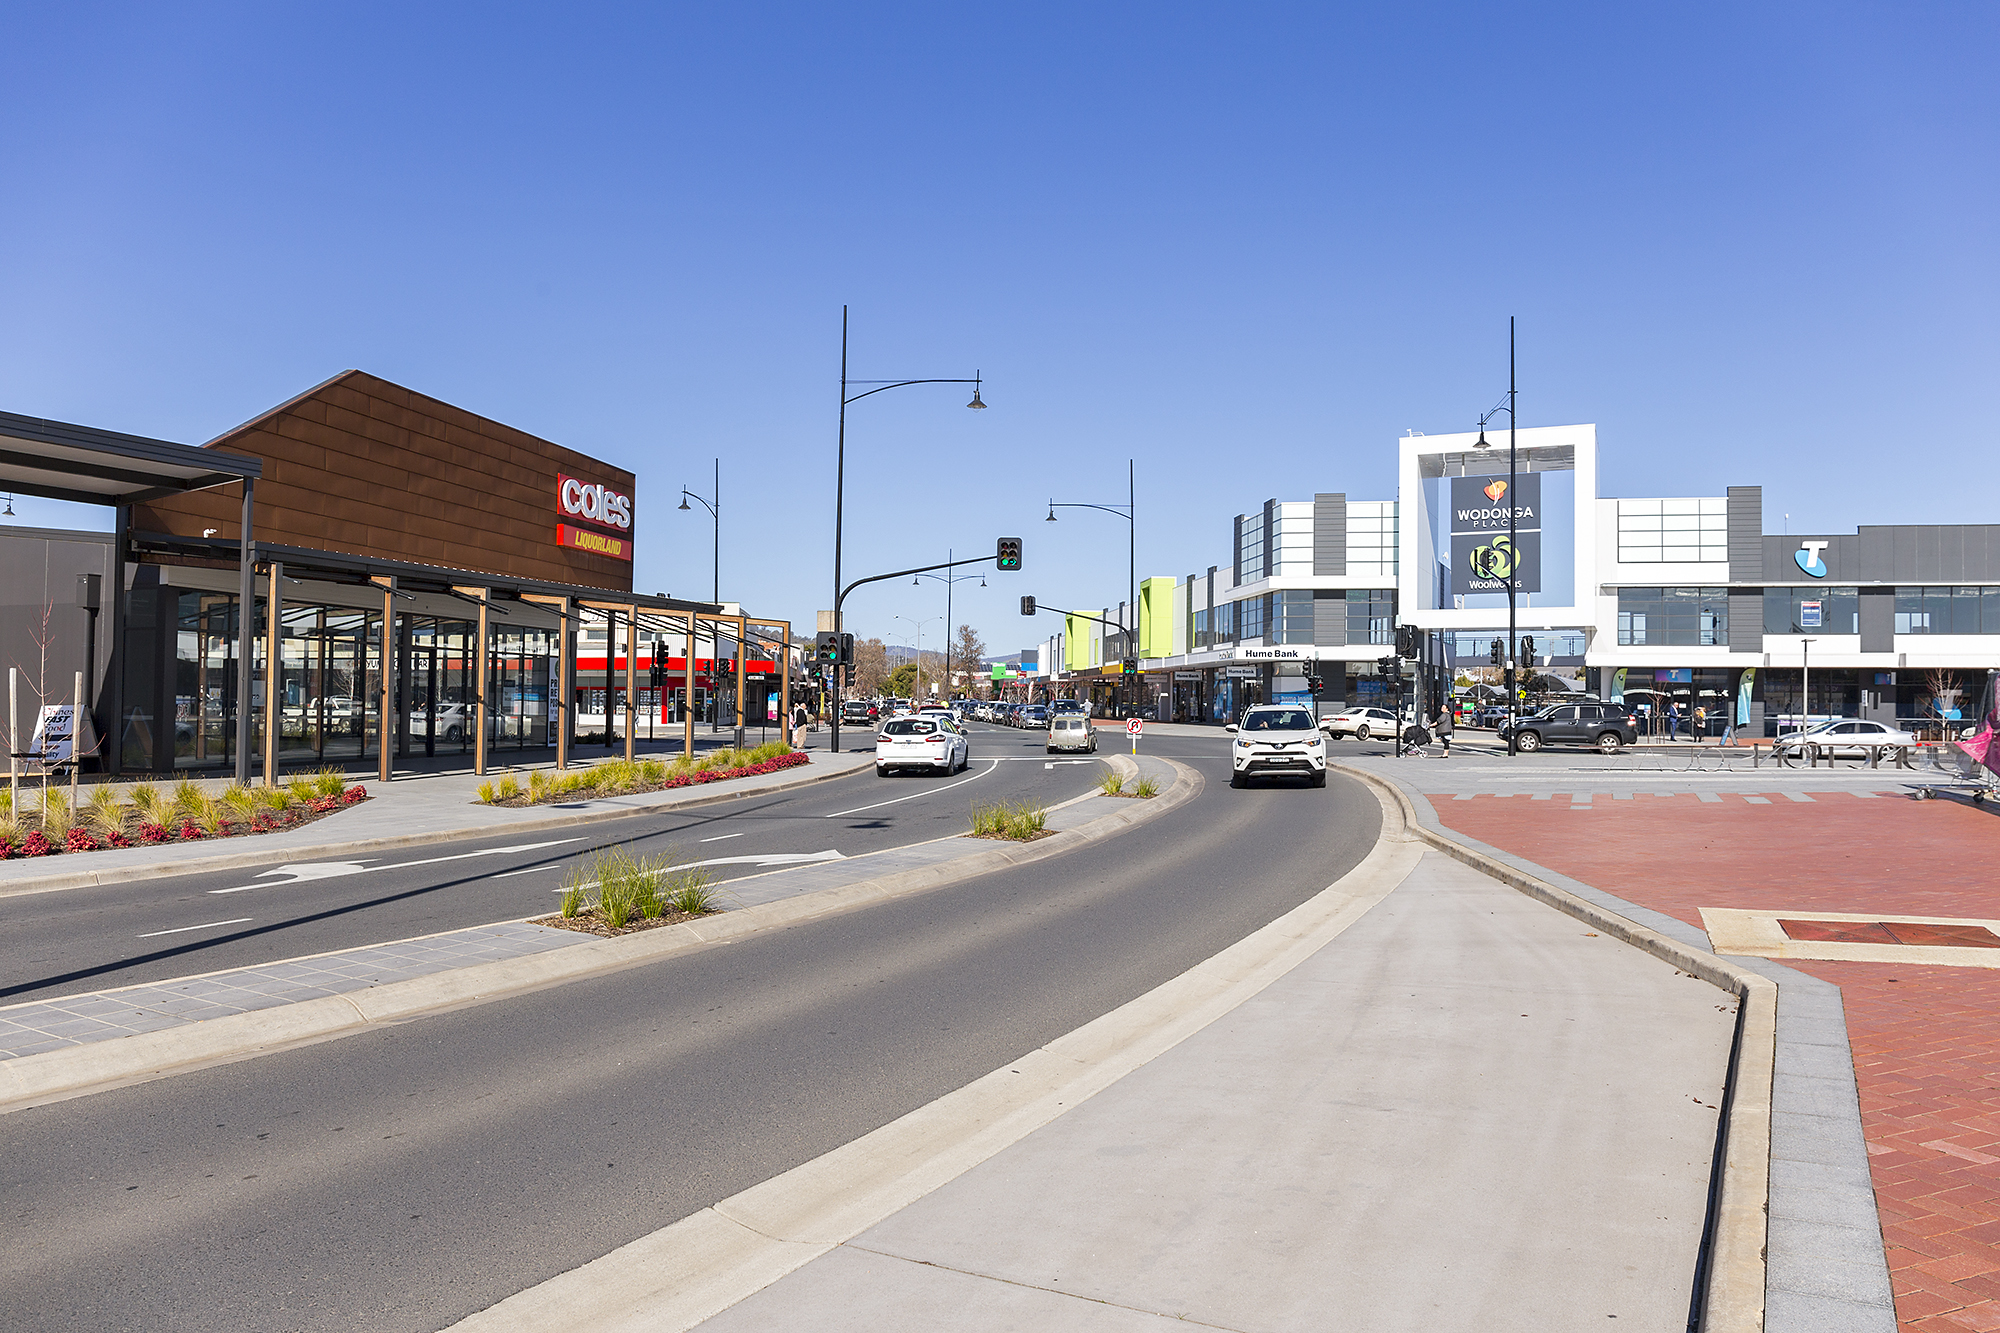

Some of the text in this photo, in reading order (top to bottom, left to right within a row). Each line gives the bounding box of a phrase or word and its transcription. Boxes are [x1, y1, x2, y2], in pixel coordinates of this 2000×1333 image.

[1457, 507, 1534, 521] WODONGA
[575, 531, 622, 555] LIQUORLAND
[1801, 541, 1829, 568] T
[1468, 579, 1522, 589] Woolwots
[1245, 649, 1299, 658] Hume Bank
[1280, 695, 1297, 704] home
[44, 715, 71, 724] FAST
